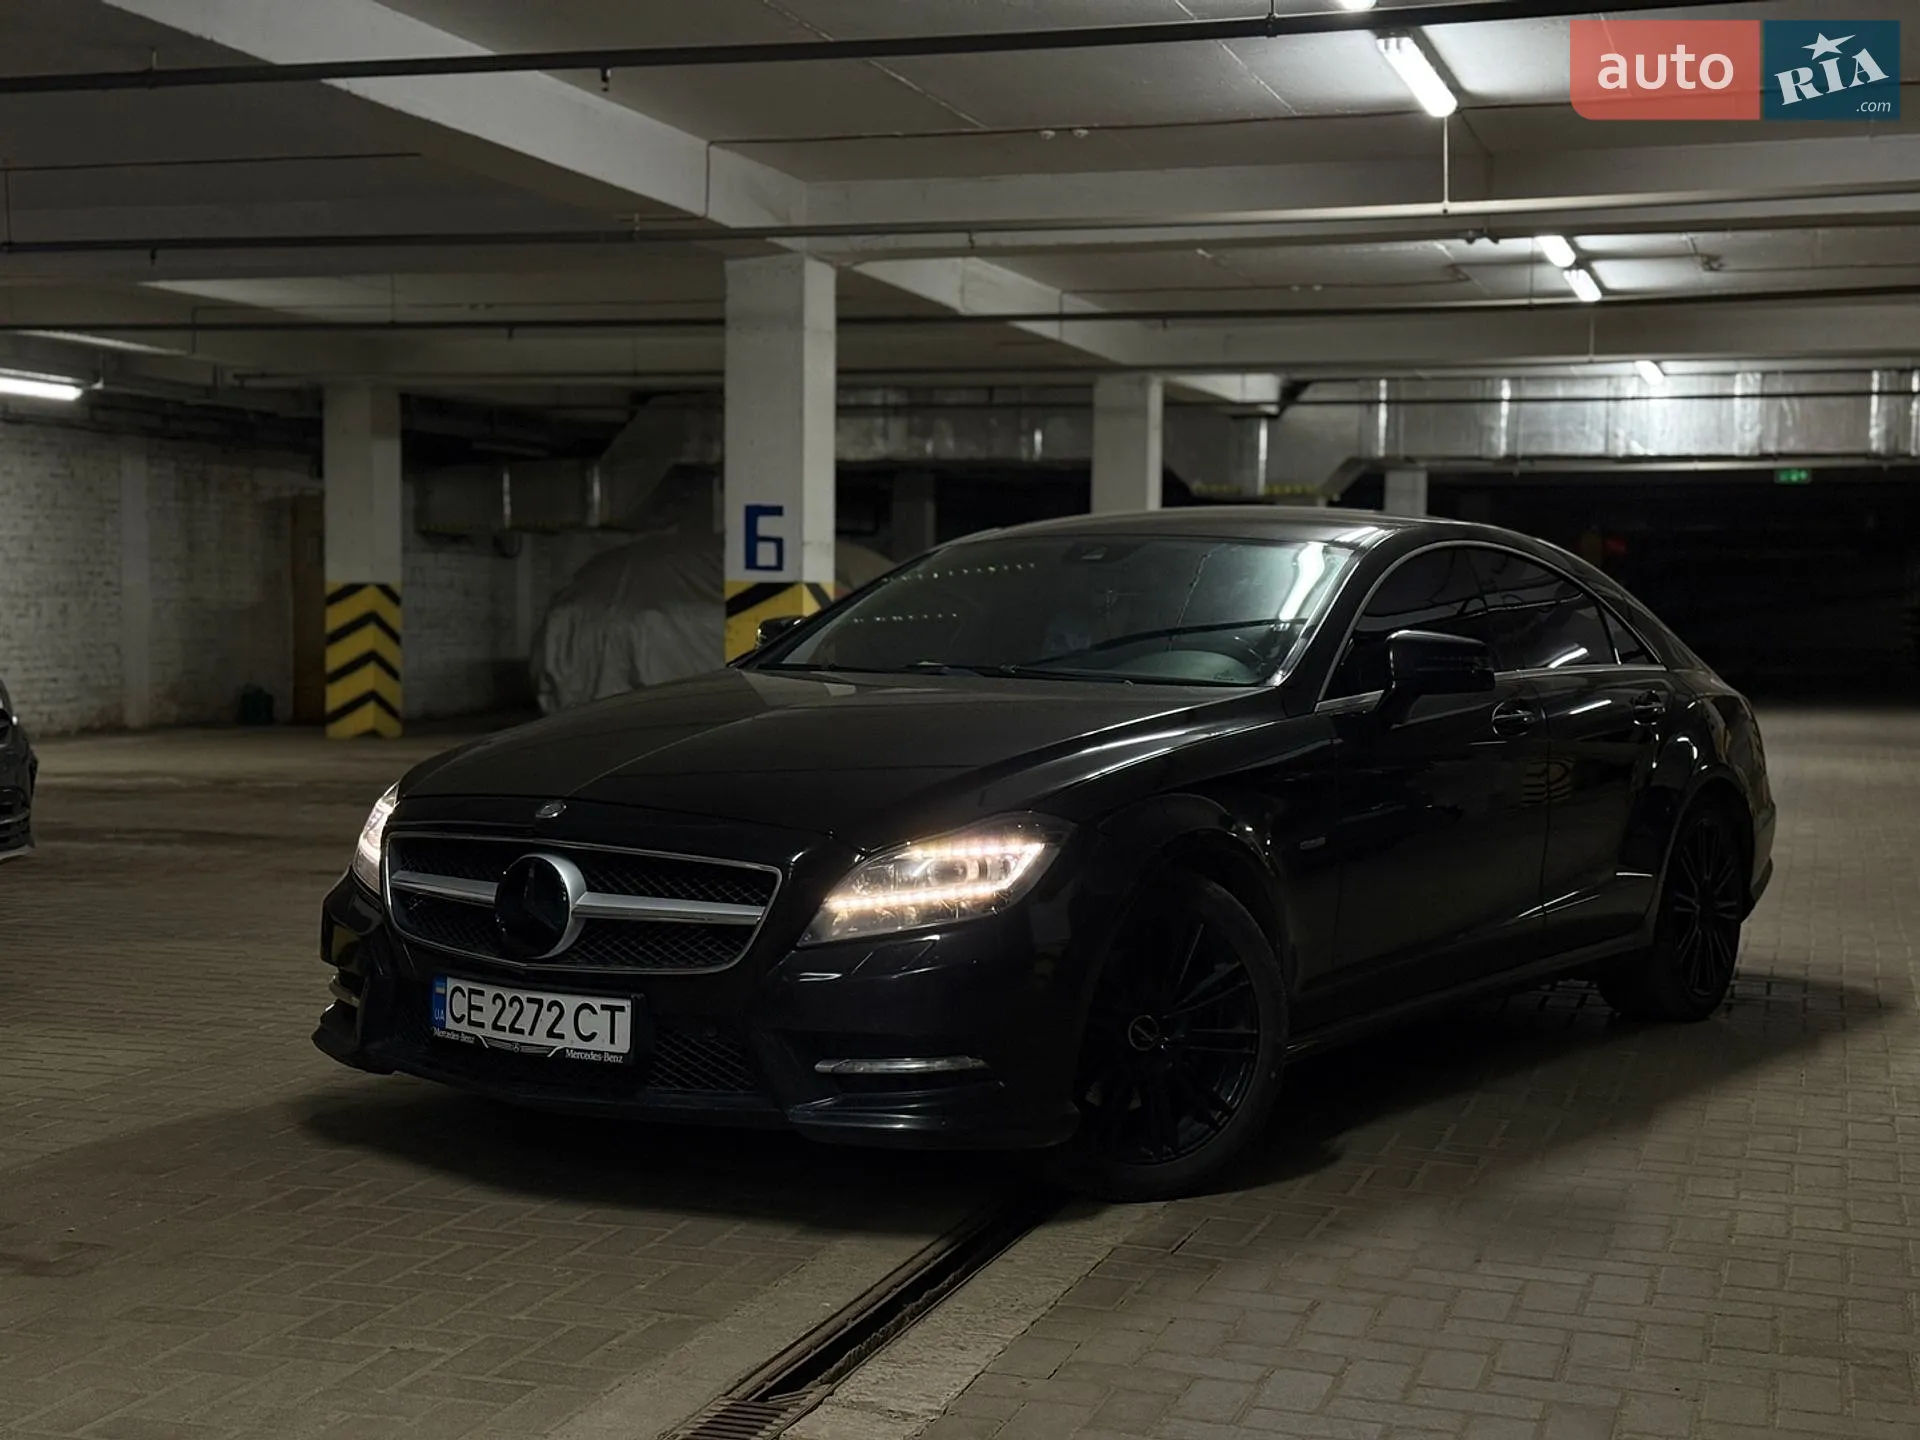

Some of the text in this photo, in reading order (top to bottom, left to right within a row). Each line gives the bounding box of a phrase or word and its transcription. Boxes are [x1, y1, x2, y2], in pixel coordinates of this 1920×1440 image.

[433, 1007, 446, 1022] UA
[449, 985, 626, 1045] CE 2272 CT
